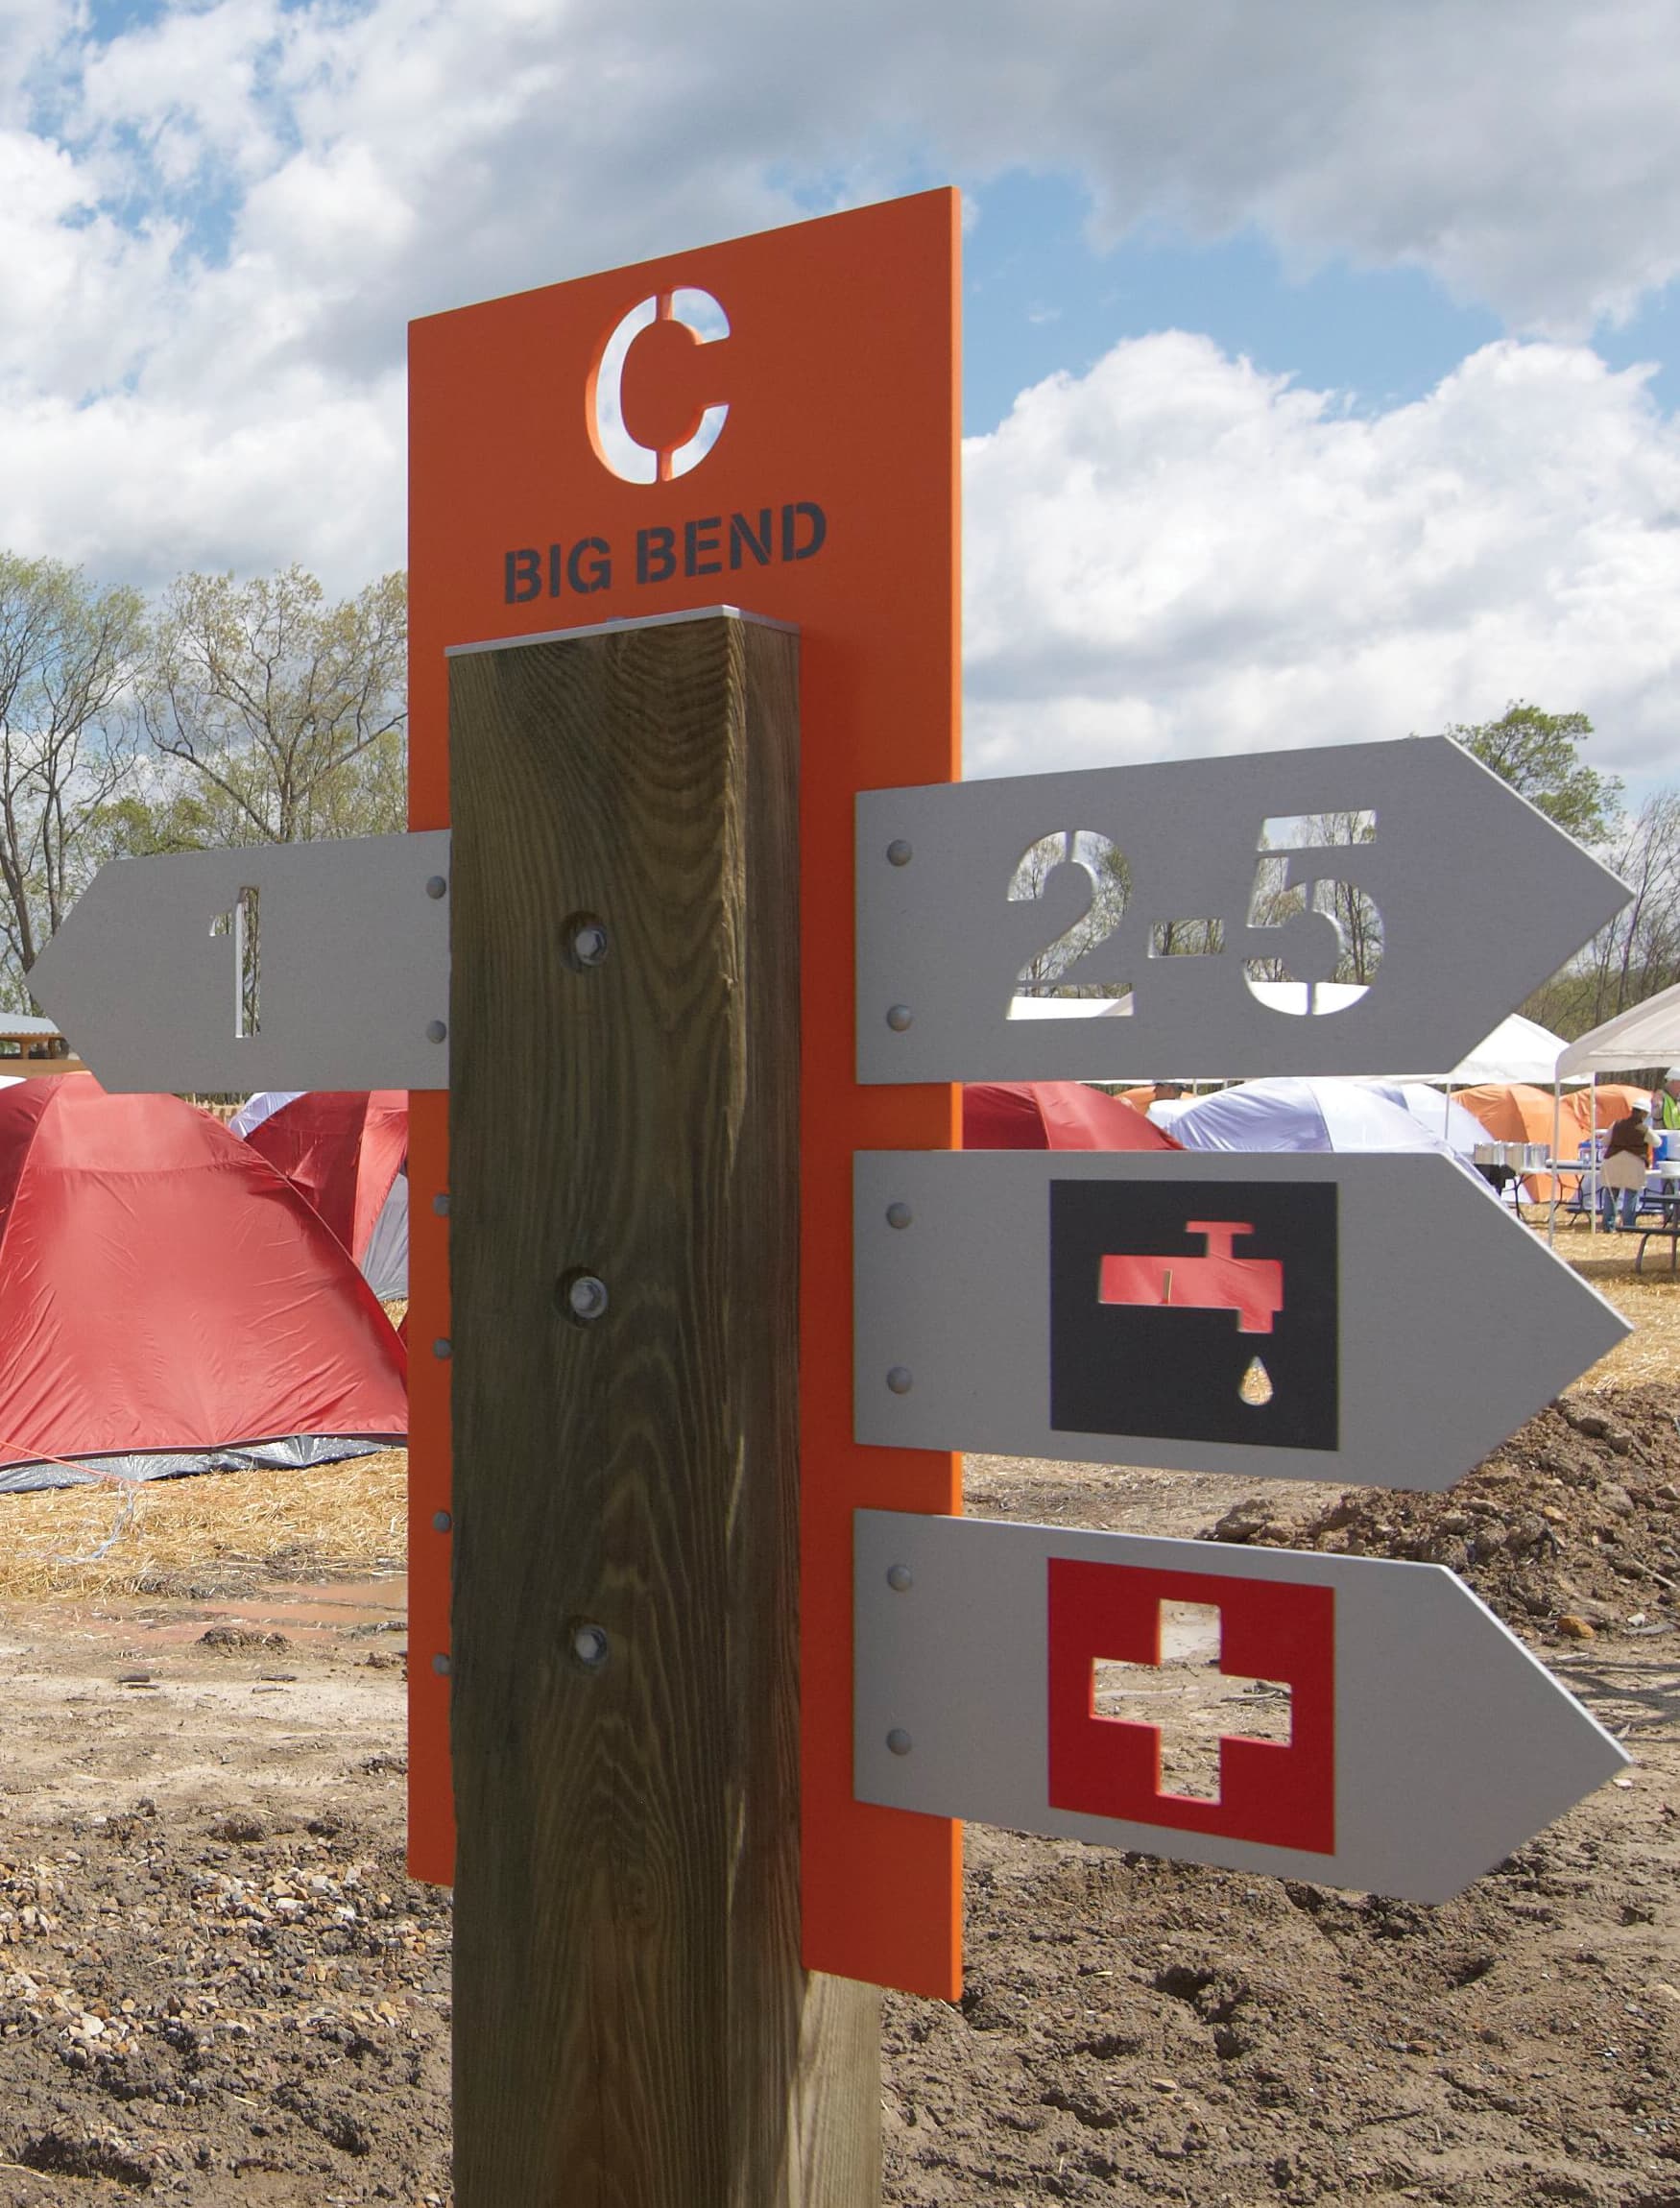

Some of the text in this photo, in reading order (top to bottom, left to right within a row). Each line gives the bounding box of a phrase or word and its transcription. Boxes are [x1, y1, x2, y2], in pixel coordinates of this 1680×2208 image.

[585, 287, 731, 485] C
[504, 501, 828, 605] BIG BEND
[208, 885, 261, 1038] 1
[1005, 809, 1384, 1020] 2-5
